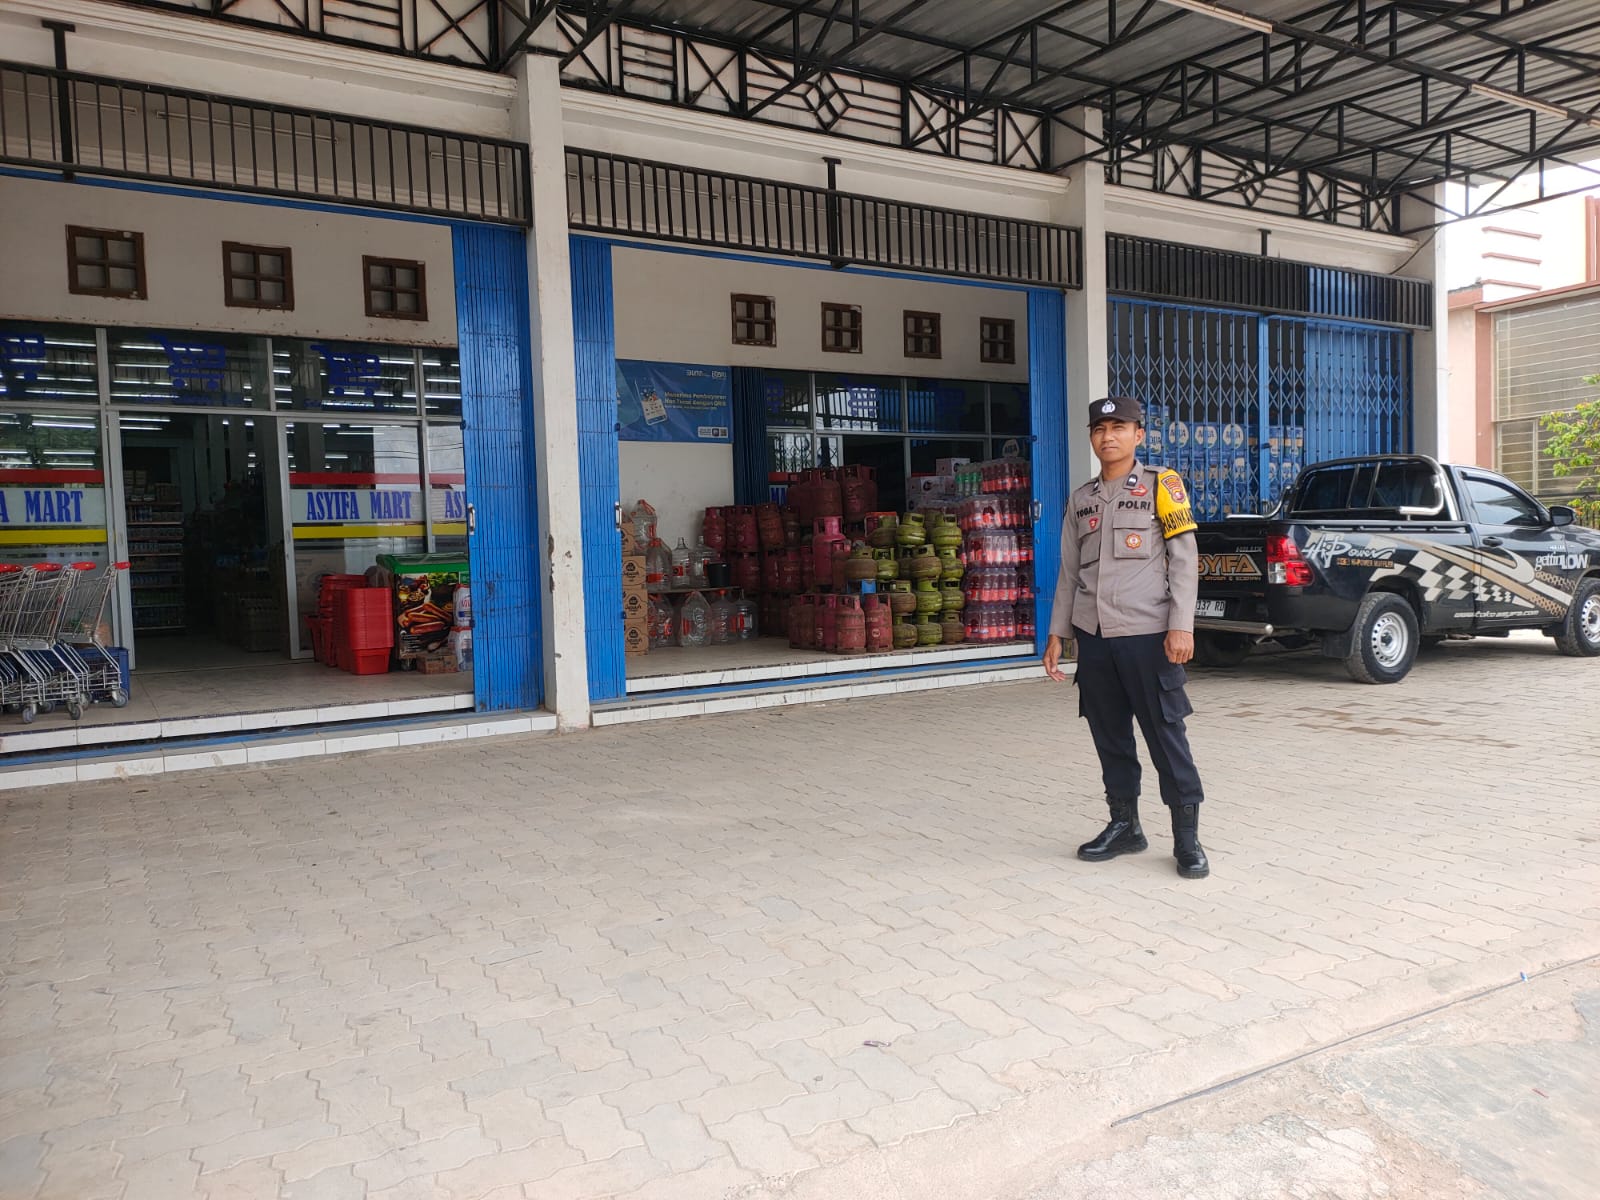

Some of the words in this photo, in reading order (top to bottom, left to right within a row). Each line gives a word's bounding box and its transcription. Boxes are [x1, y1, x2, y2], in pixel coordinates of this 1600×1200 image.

[24, 490, 83, 523] MART
[306, 491, 360, 521] ASYIFA
[369, 491, 412, 520] MART
[1118, 501, 1152, 511] POLRI
